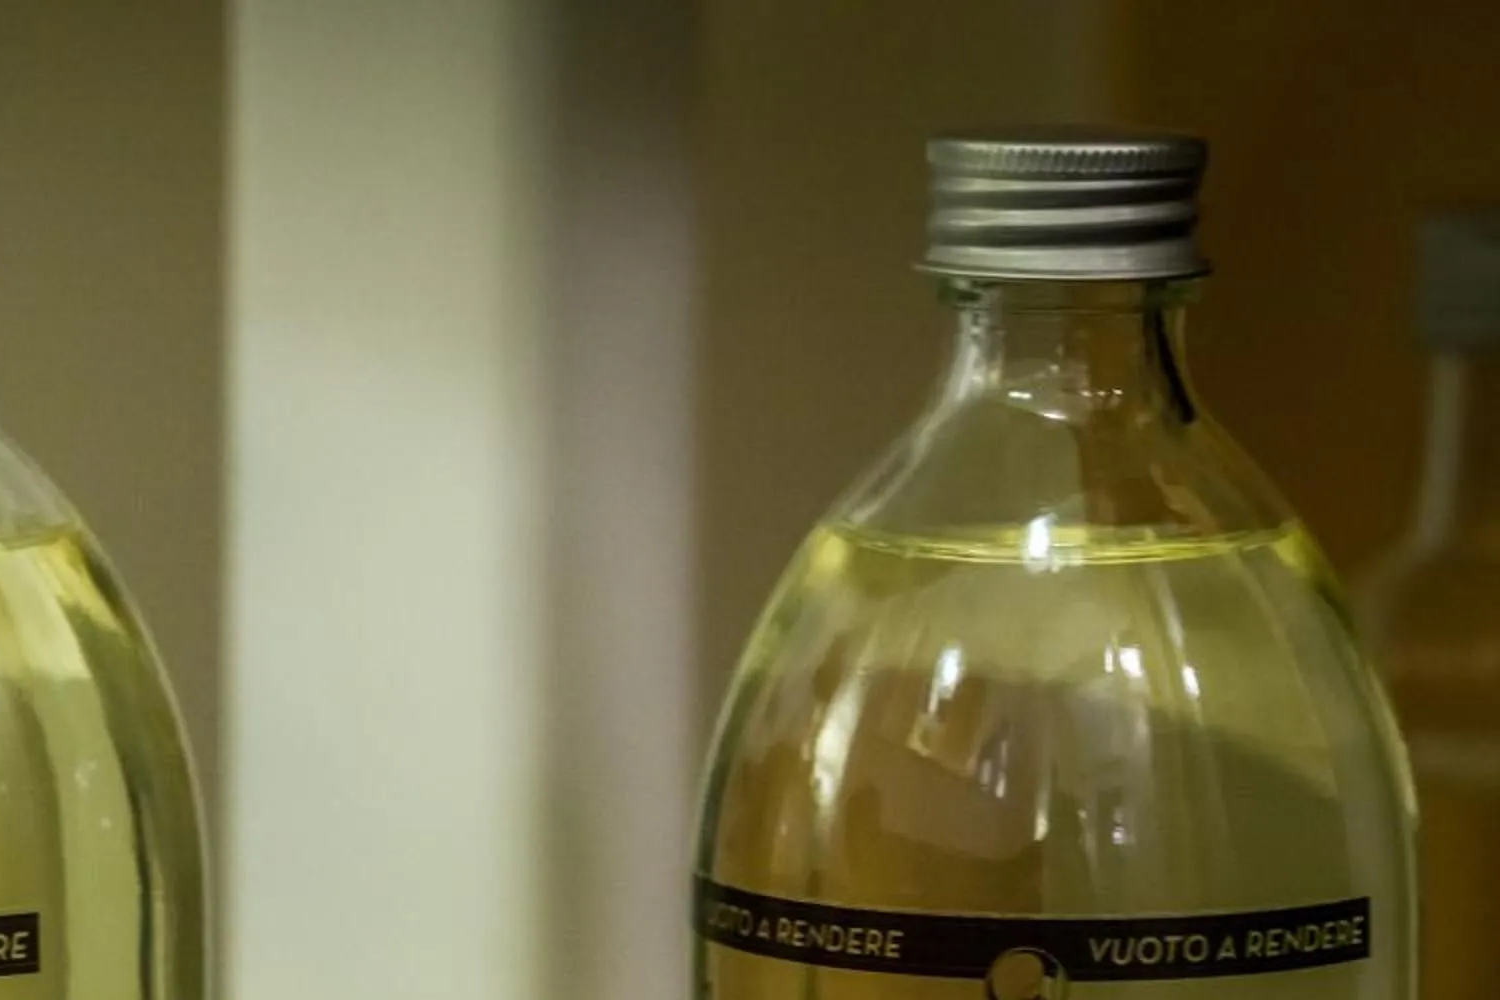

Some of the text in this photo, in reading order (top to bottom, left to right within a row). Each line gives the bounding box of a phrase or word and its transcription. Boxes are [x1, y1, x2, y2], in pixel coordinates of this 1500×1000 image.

[757, 917, 771, 939] A
[776, 918, 904, 958] RENDERE
[1089, 916, 1364, 965] VUOTO A RENDERE
